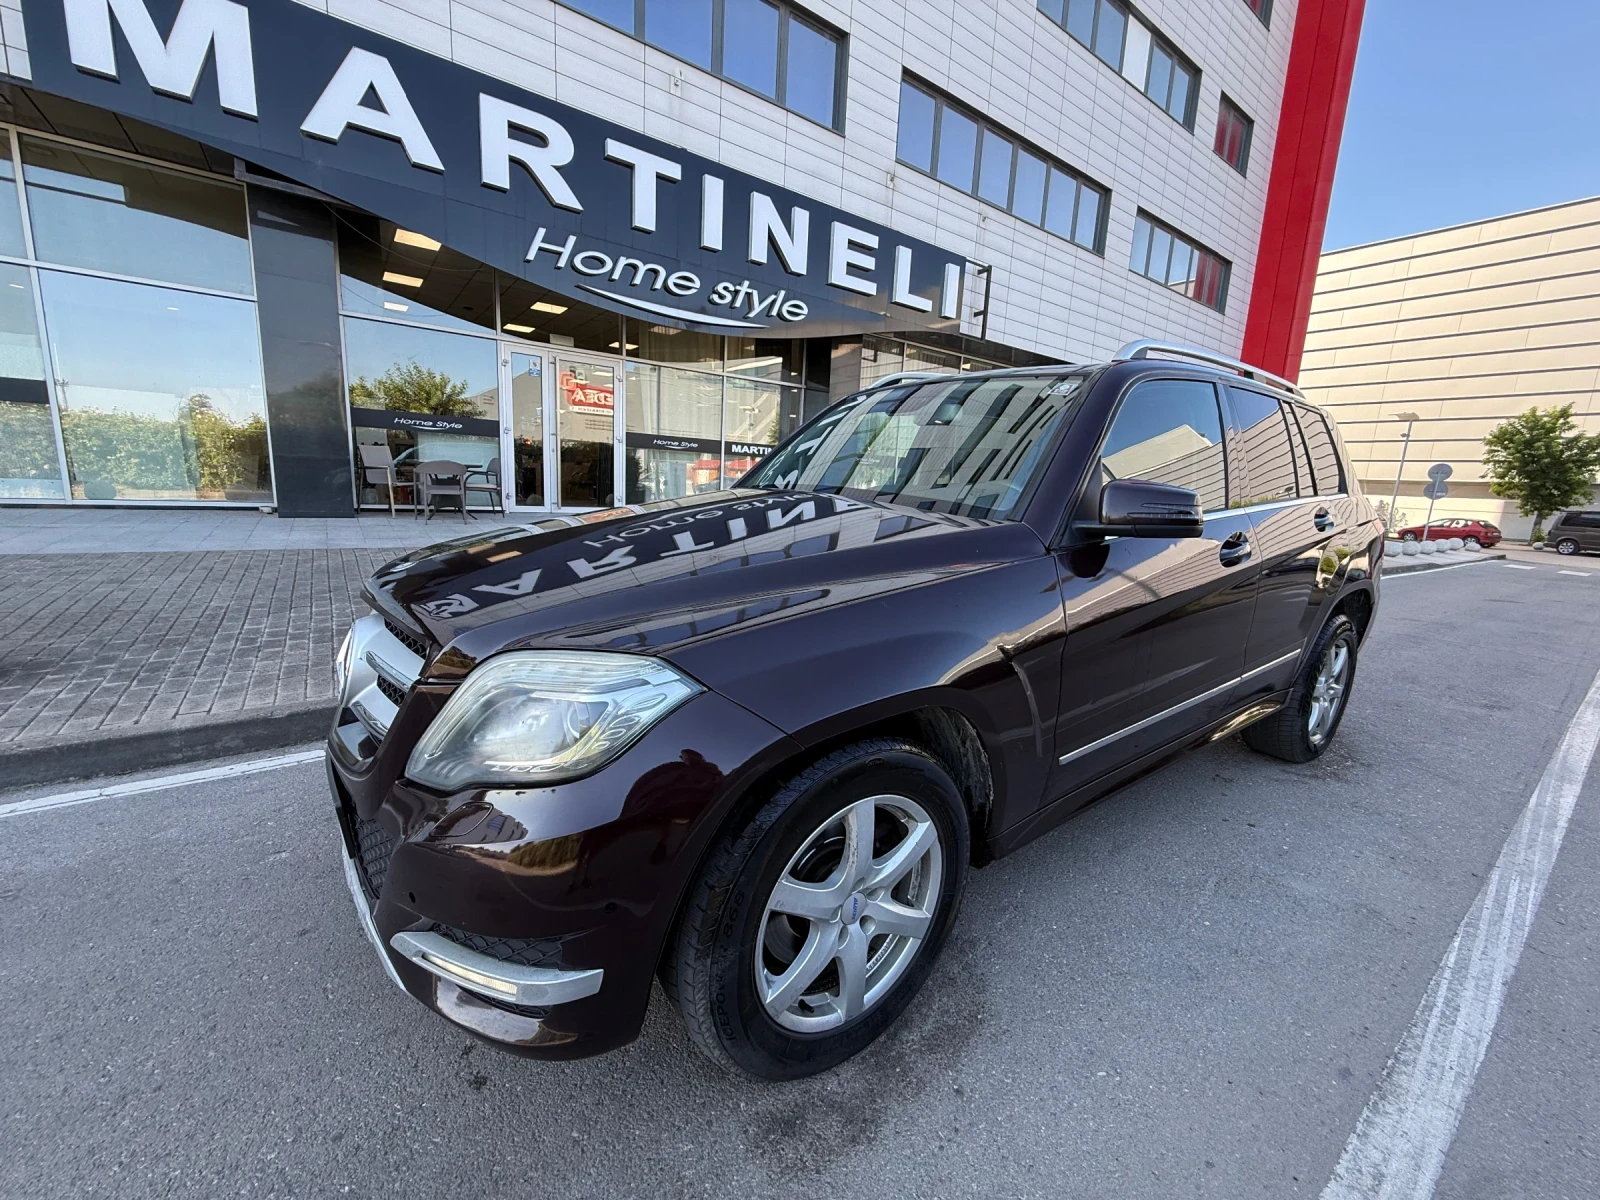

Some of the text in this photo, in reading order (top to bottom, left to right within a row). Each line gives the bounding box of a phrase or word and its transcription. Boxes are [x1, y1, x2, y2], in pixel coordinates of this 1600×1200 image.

[64, 0, 961, 319] MARTINELI
[524, 226, 809, 323] Home style
[394, 418, 463, 429] Home Style
